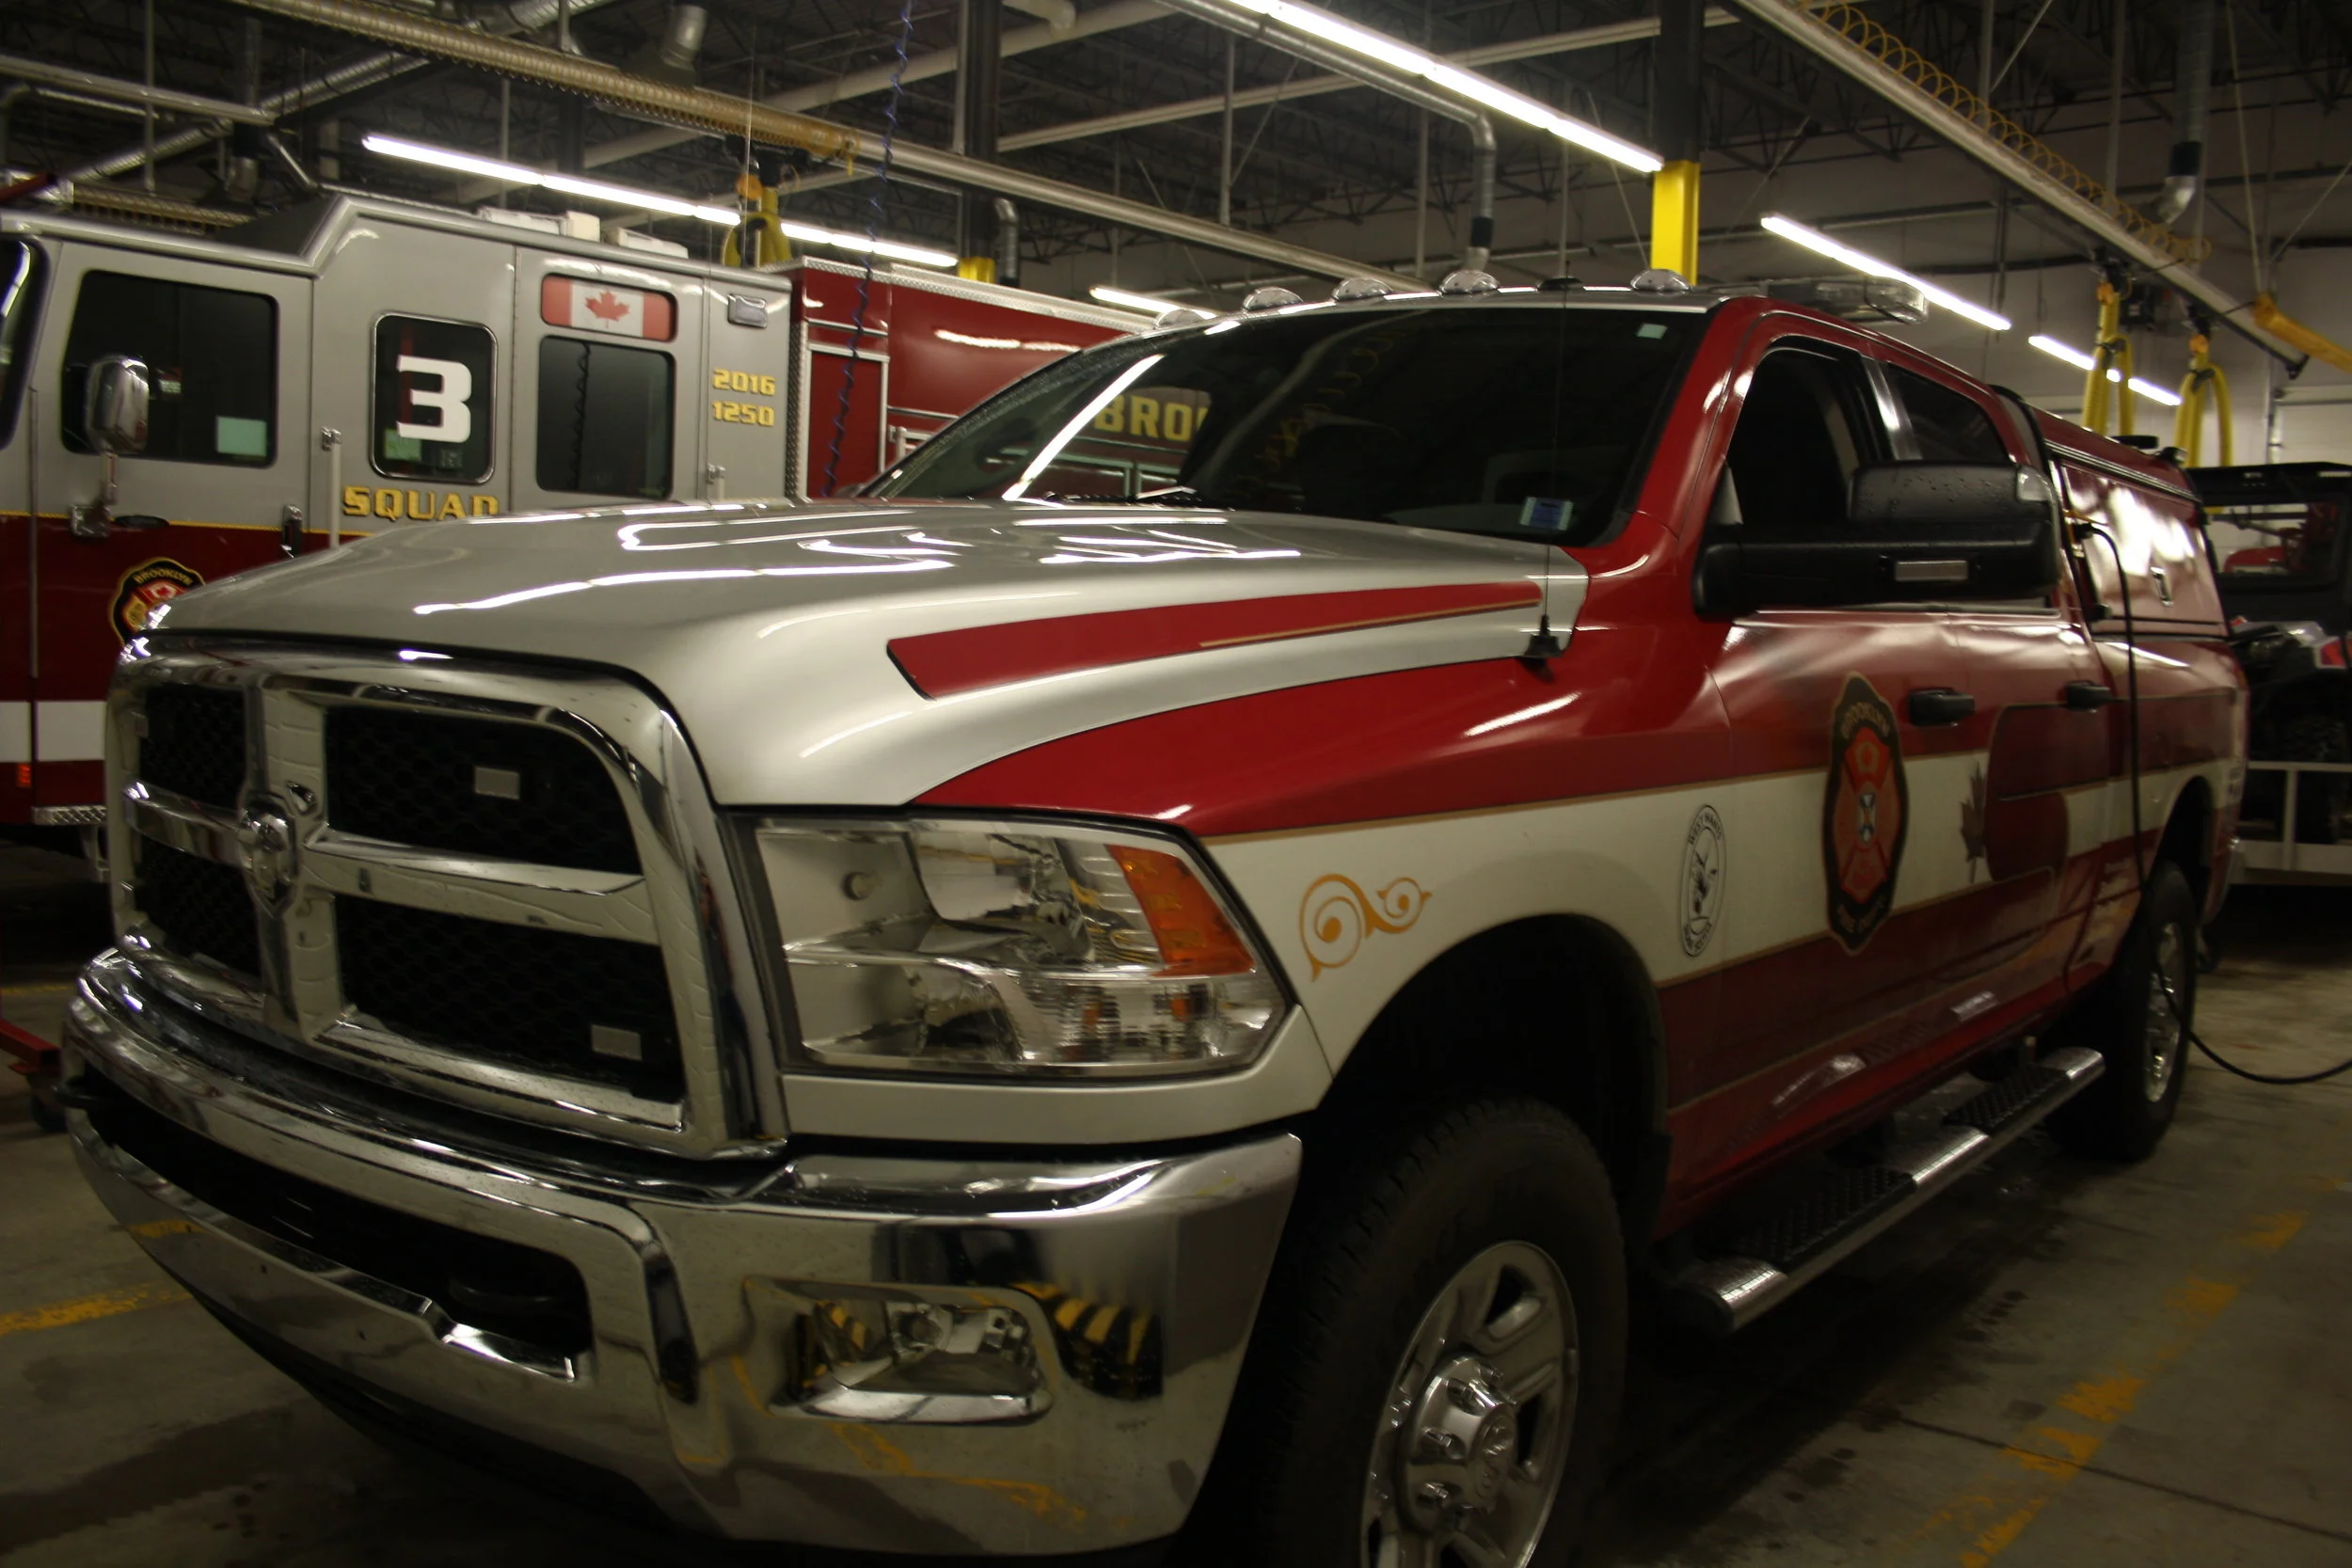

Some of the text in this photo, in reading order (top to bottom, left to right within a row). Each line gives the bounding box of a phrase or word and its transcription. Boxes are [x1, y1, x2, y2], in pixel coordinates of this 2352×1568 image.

[713, 369, 775, 396] 2016
[396, 354, 472, 443] 3
[712, 401, 775, 426] 1250
[343, 485, 500, 521] SQUAD
[133, 567, 194, 586] BROOKLYN
